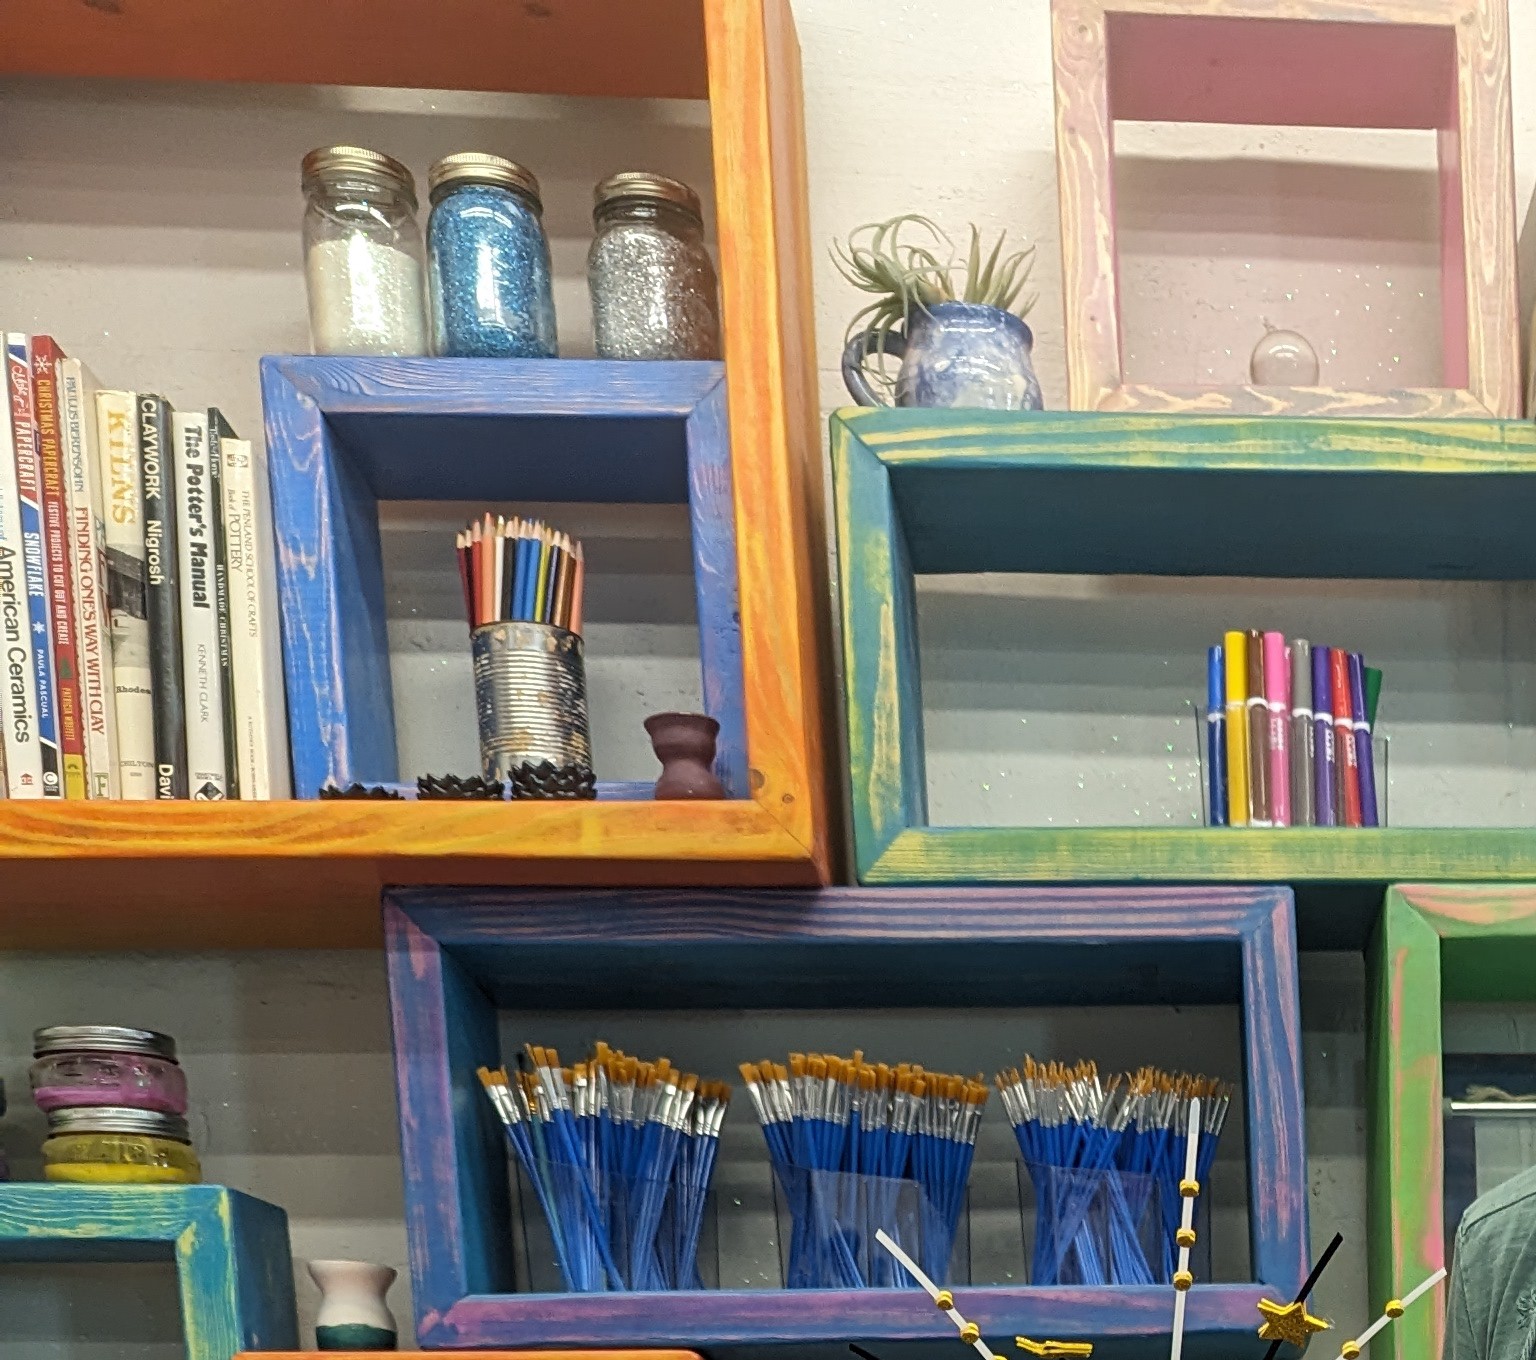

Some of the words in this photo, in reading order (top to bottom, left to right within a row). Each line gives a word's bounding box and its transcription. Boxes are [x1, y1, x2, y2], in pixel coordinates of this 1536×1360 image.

[37, 379, 56, 434] CHRISTMAS
[65, 377, 79, 420] PAULUS
[15, 421, 36, 492] PAPERCRAFT
[42, 438, 59, 496] PAPERCRAFT
[107, 410, 137, 527] KILNS
[141, 399, 161, 500] CLAYWORK
[185, 426, 203, 458] The
[47, 501, 59, 527] FESTIVE
[187, 463, 207, 536] Potter's
[24, 532, 44, 597] SNOWFLAKE
[50, 529, 62, 561] PROJECTS
[76, 507, 94, 572] FINDING
[146, 520, 164, 585] Nigrosh
[229, 514, 243, 572] POTTERY
[190, 542, 210, 609] Manual
[242, 508, 254, 552] PENLAND
[248, 604, 258, 637] CRAFTS
[56, 604, 68, 619] AND
[38, 649, 46, 677] PAULA
[83, 624, 99, 658] WAY
[197, 643, 207, 689] KENNETH
[7, 647, 32, 743] Ceramics
[38, 680, 49, 718] PASCUAL
[86, 658, 101, 703] WITH
[199, 692, 209, 723] CLARK
